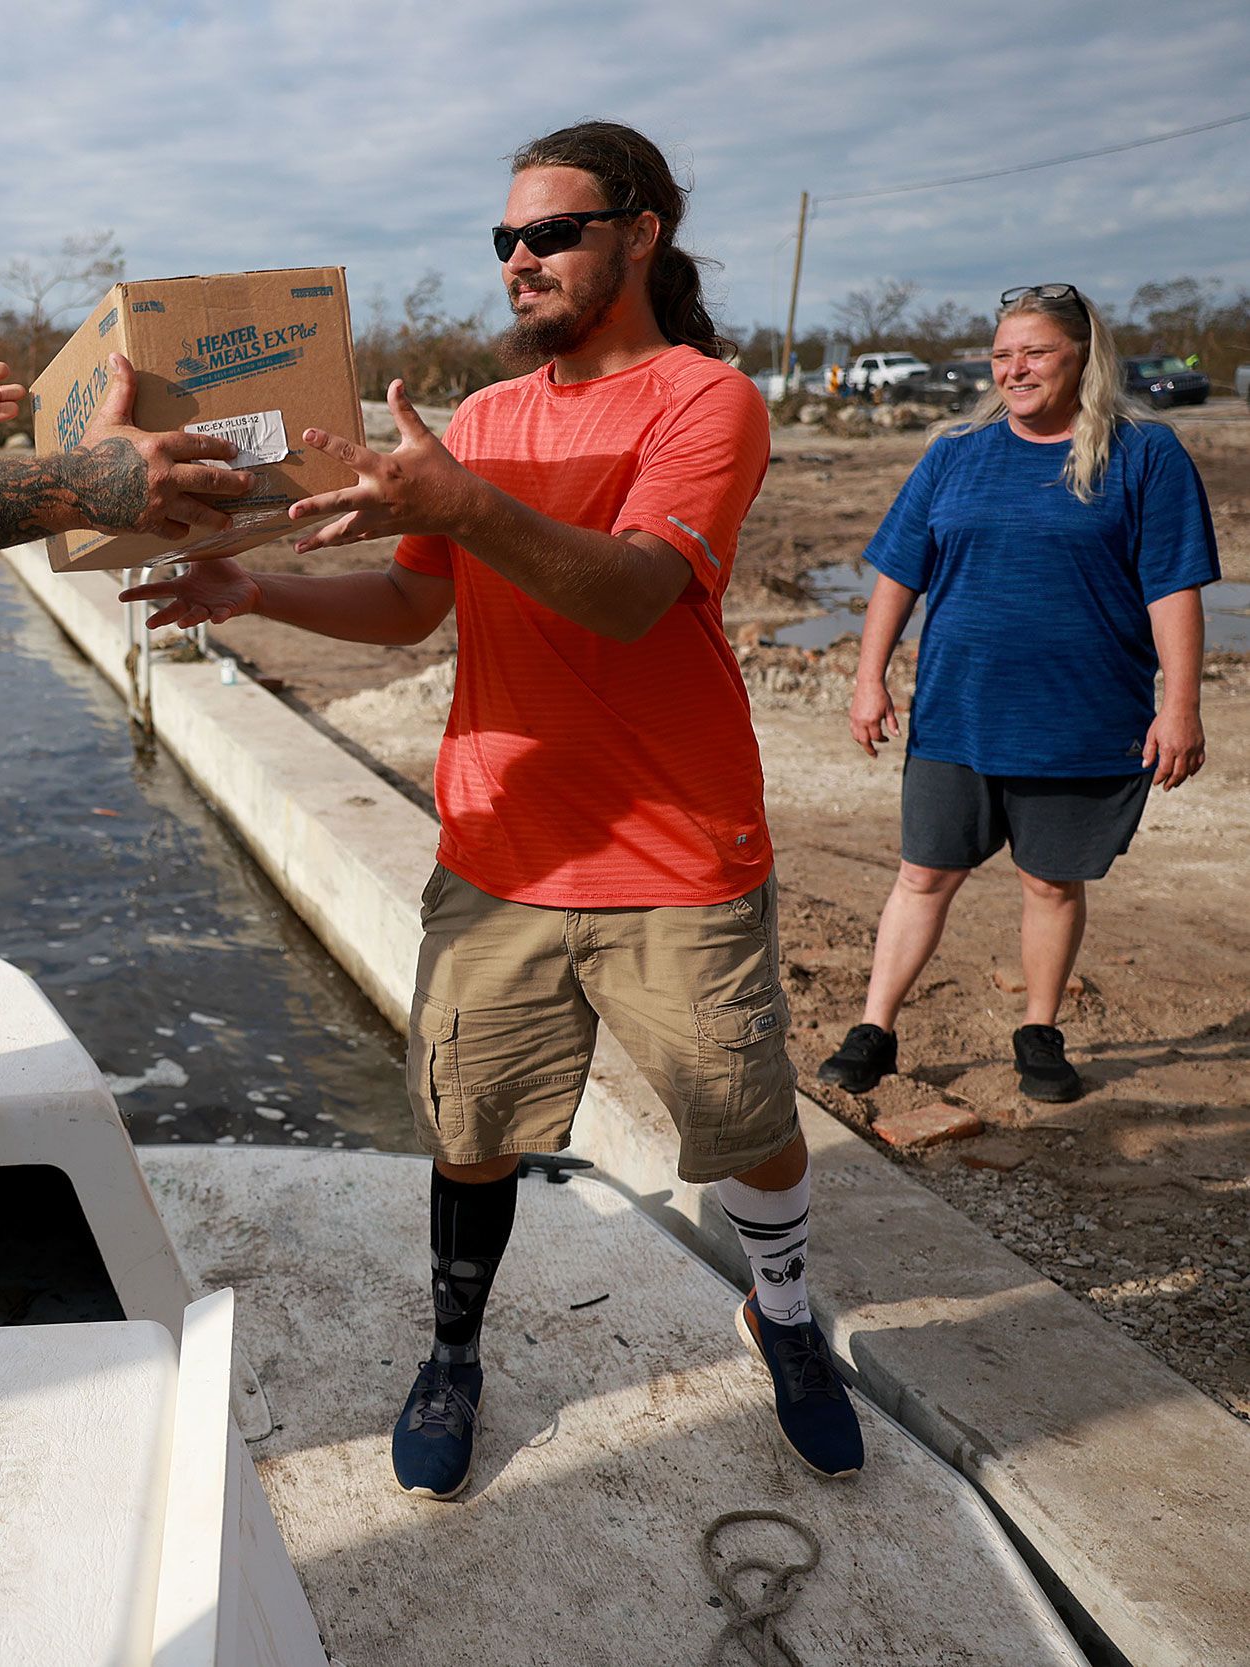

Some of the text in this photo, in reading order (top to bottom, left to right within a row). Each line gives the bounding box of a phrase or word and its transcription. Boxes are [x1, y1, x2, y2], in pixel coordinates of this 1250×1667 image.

[132, 303, 150, 313] USA
[196, 325, 258, 356] HEATER
[263, 328, 288, 349] EX
[57, 380, 81, 446] HEATER
[197, 415, 259, 433] MC-EX PLUS-12
